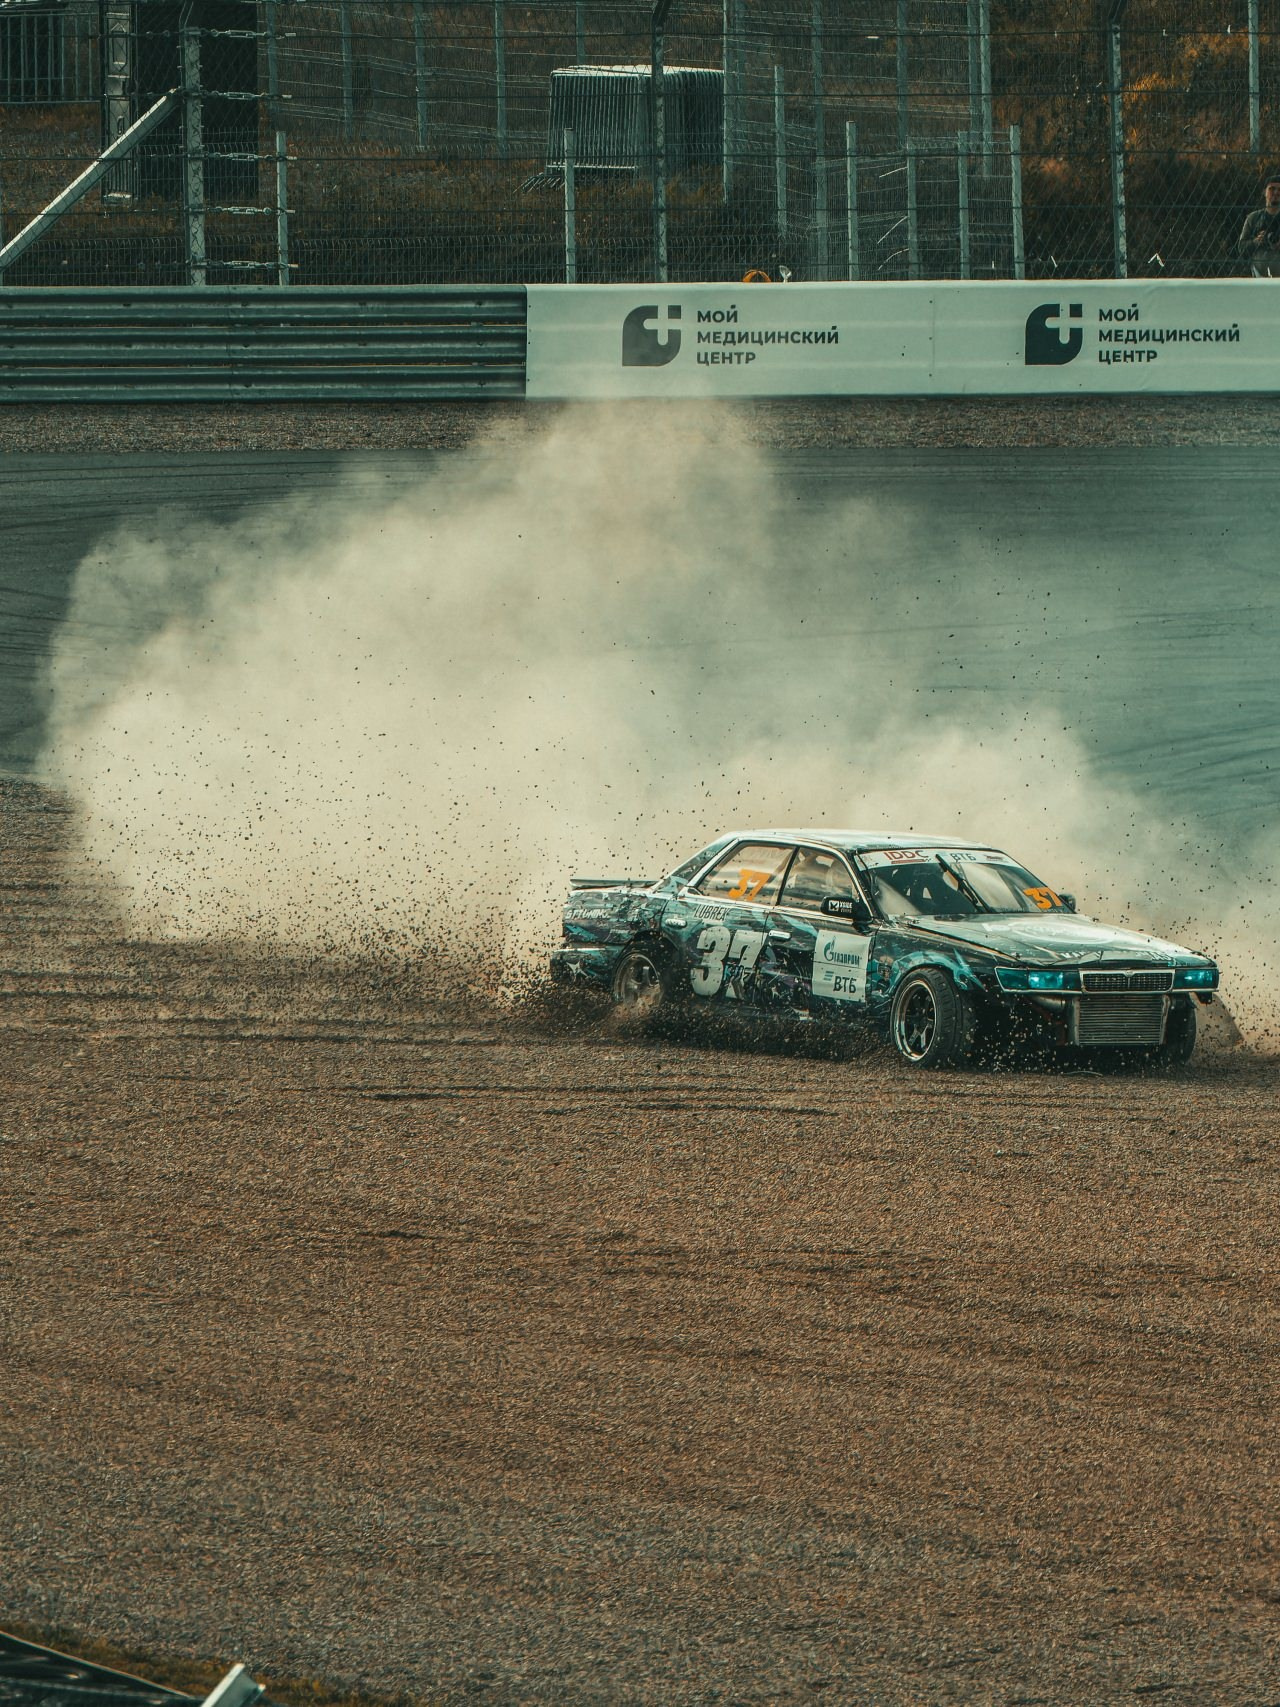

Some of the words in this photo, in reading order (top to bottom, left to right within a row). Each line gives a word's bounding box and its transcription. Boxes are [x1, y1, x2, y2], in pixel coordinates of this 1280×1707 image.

[697, 304, 738, 323] МОЙ
[1098, 302, 1140, 322] МОЙ
[697, 325, 839, 346] МЕДИЦИНСКИЙ
[1098, 323, 1240, 345] МЕДИЦИНСКИЙ
[696, 351, 756, 366] ЦЕНТР
[1098, 349, 1158, 366] ЦЕНТР
[883, 850, 929, 861] IDDC
[728, 869, 772, 902] 37
[1023, 886, 1063, 910] 37
[693, 903, 731, 922] LUBREX
[690, 925, 768, 999] 37
[833, 975, 857, 993] ВТБ
